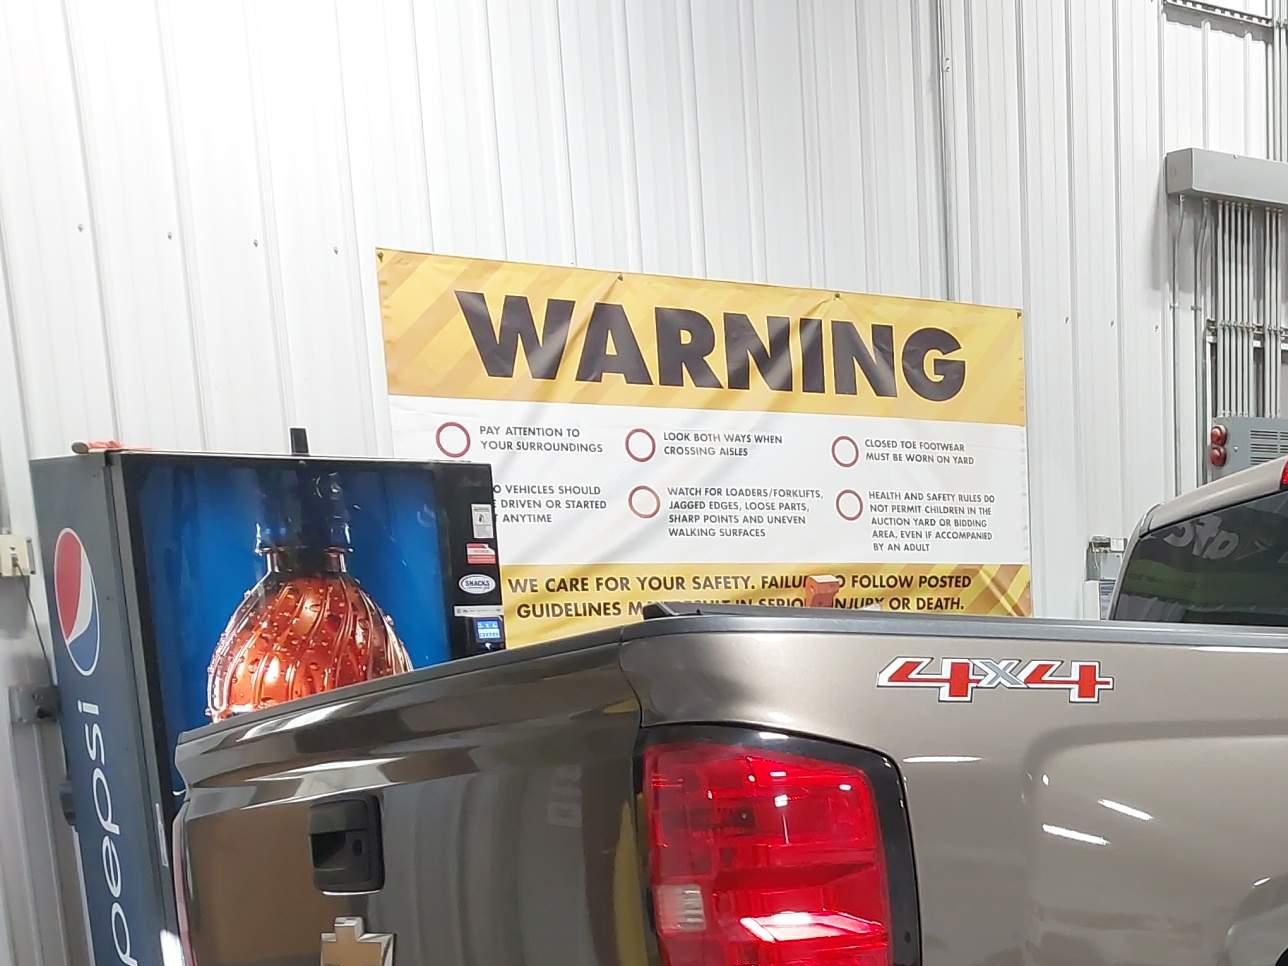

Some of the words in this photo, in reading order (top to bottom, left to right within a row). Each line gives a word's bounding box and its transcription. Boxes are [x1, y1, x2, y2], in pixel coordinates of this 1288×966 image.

[454, 290, 966, 402] WARNING
[480, 426, 500, 435] PAY
[505, 426, 563, 437] ATTENTION
[566, 428, 580, 438] TO
[664, 432, 690, 441] LOOK
[694, 433, 721, 442] BOTH
[724, 434, 751, 443] WAYS
[754, 434, 782, 444] WHEN
[480, 440, 513, 450] YOUR
[516, 441, 603, 453] SURROUNDINGS
[664, 446, 716, 455] CROSSING
[720, 447, 748, 456] AISLES
[865, 439, 897, 449] CLOSED
[900, 440, 917, 449] TOE
[920, 441, 964, 451] FOOTWEAR
[866, 452, 890, 461] MUST
[893, 453, 903, 462] BE
[905, 454, 934, 463] WORN
[937, 455, 950, 464] ON
[953, 455, 974, 465] YARD
[493, 484, 501, 494] O
[505, 485, 554, 494] VEHICLES
[558, 485, 601, 495] SHOULD
[667, 487, 701, 496] WATCH
[704, 488, 722, 497] FOR
[726, 487, 824, 499] LOADERS/FORKLIFTS,
[869, 491, 901, 500] HEALTH
[904, 492, 924, 501] AND
[926, 493, 955, 502] SAFETY
[958, 494, 982, 503] RULES
[984, 494, 995, 503] DO
[501, 499, 542, 509] DRIVEN
[545, 500, 561, 509] OR
[565, 500, 607, 509] STARTED
[669, 501, 706, 510] JAGGED
[709, 501, 742, 512] EDGES,
[745, 501, 776, 511] LOOSE
[779, 502, 810, 513] PARTS,
[870, 504, 888, 513] NOT
[891, 505, 921, 514] PERMIT
[924, 505, 964, 515] CHILDREN
[967, 507, 976, 515] IN
[978, 507, 992, 516] THE
[502, 514, 553, 523] ANYTIME
[669, 514, 700, 523] SHARP
[703, 515, 739, 524] POINTS
[742, 515, 764, 524] AND
[767, 515, 806, 524] UNEVEN
[871, 517, 910, 526] AUCTION
[913, 518, 936, 527] YARD
[939, 518, 951, 527] OR
[954, 519, 987, 528] BIDDING
[669, 528, 716, 537] WALKING
[719, 528, 766, 537] SURFACES
[872, 530, 898, 540] AREA,
[900, 530, 922, 539] EVEN
[925, 531, 932, 539] IF
[935, 531, 993, 540] ACCOMPANIED
[873, 543, 884, 552] BY
[887, 543, 901, 552] AN
[903, 543, 930, 552] ADULT
[508, 578, 538, 593] WE
[545, 577, 589, 592] CARE
[596, 576, 631, 592] FOR
[636, 576, 686, 591] YOUR
[692, 575, 756, 591] SAFETY.
[761, 575, 807, 590] FAILU
[851, 575, 912, 589] FOLLOW
[918, 575, 972, 589] POSTED
[517, 601, 622, 618] GUIDELINES
[889, 597, 911, 610] OR
[916, 597, 965, 610] DEATH.
